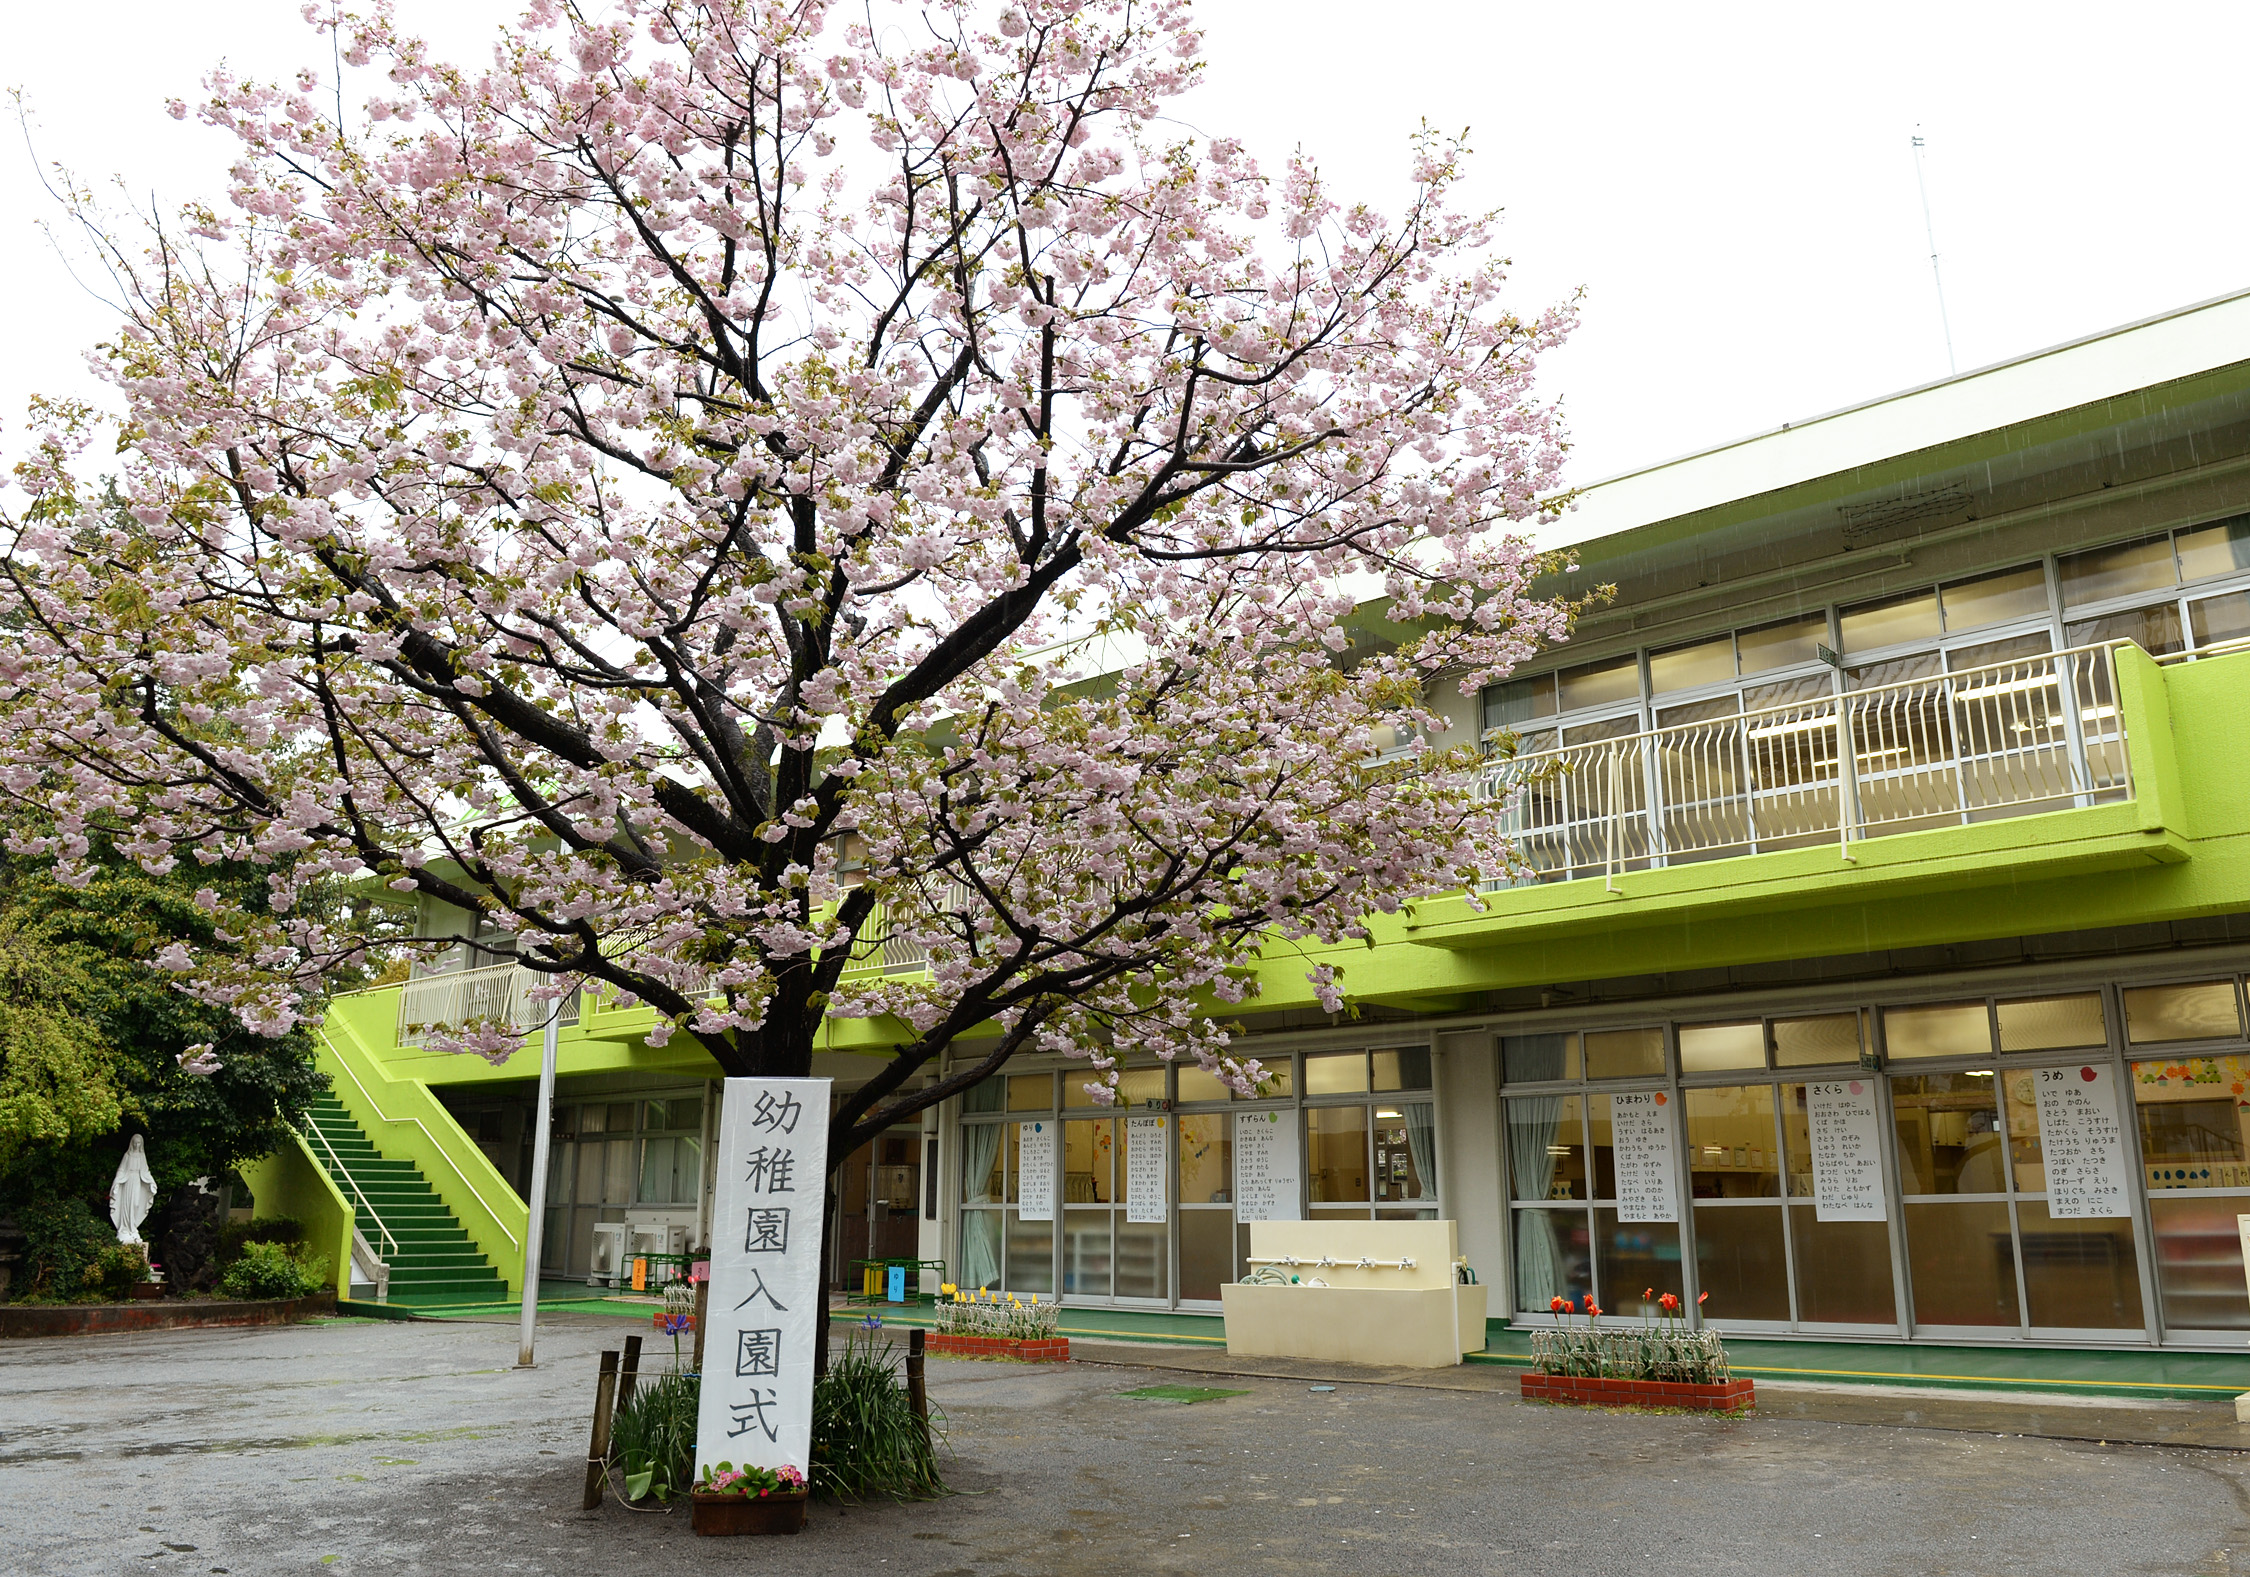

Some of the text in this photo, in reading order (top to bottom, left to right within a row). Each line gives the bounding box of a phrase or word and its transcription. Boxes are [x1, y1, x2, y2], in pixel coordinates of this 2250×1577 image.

[2152, 1056, 2239, 1076] 7 8 9
[2042, 1071, 2063, 1082] うめ
[1813, 1085, 1842, 1095] さくら
[1616, 1094, 1650, 1104] ひまわり
[1148, 1100, 1161, 1110] ゆり
[1132, 1119, 1155, 1127] たんぽぽ
[1240, 1115, 1266, 1123] すずらん
[727, 1090, 802, 1443] 幼稚園入園式
